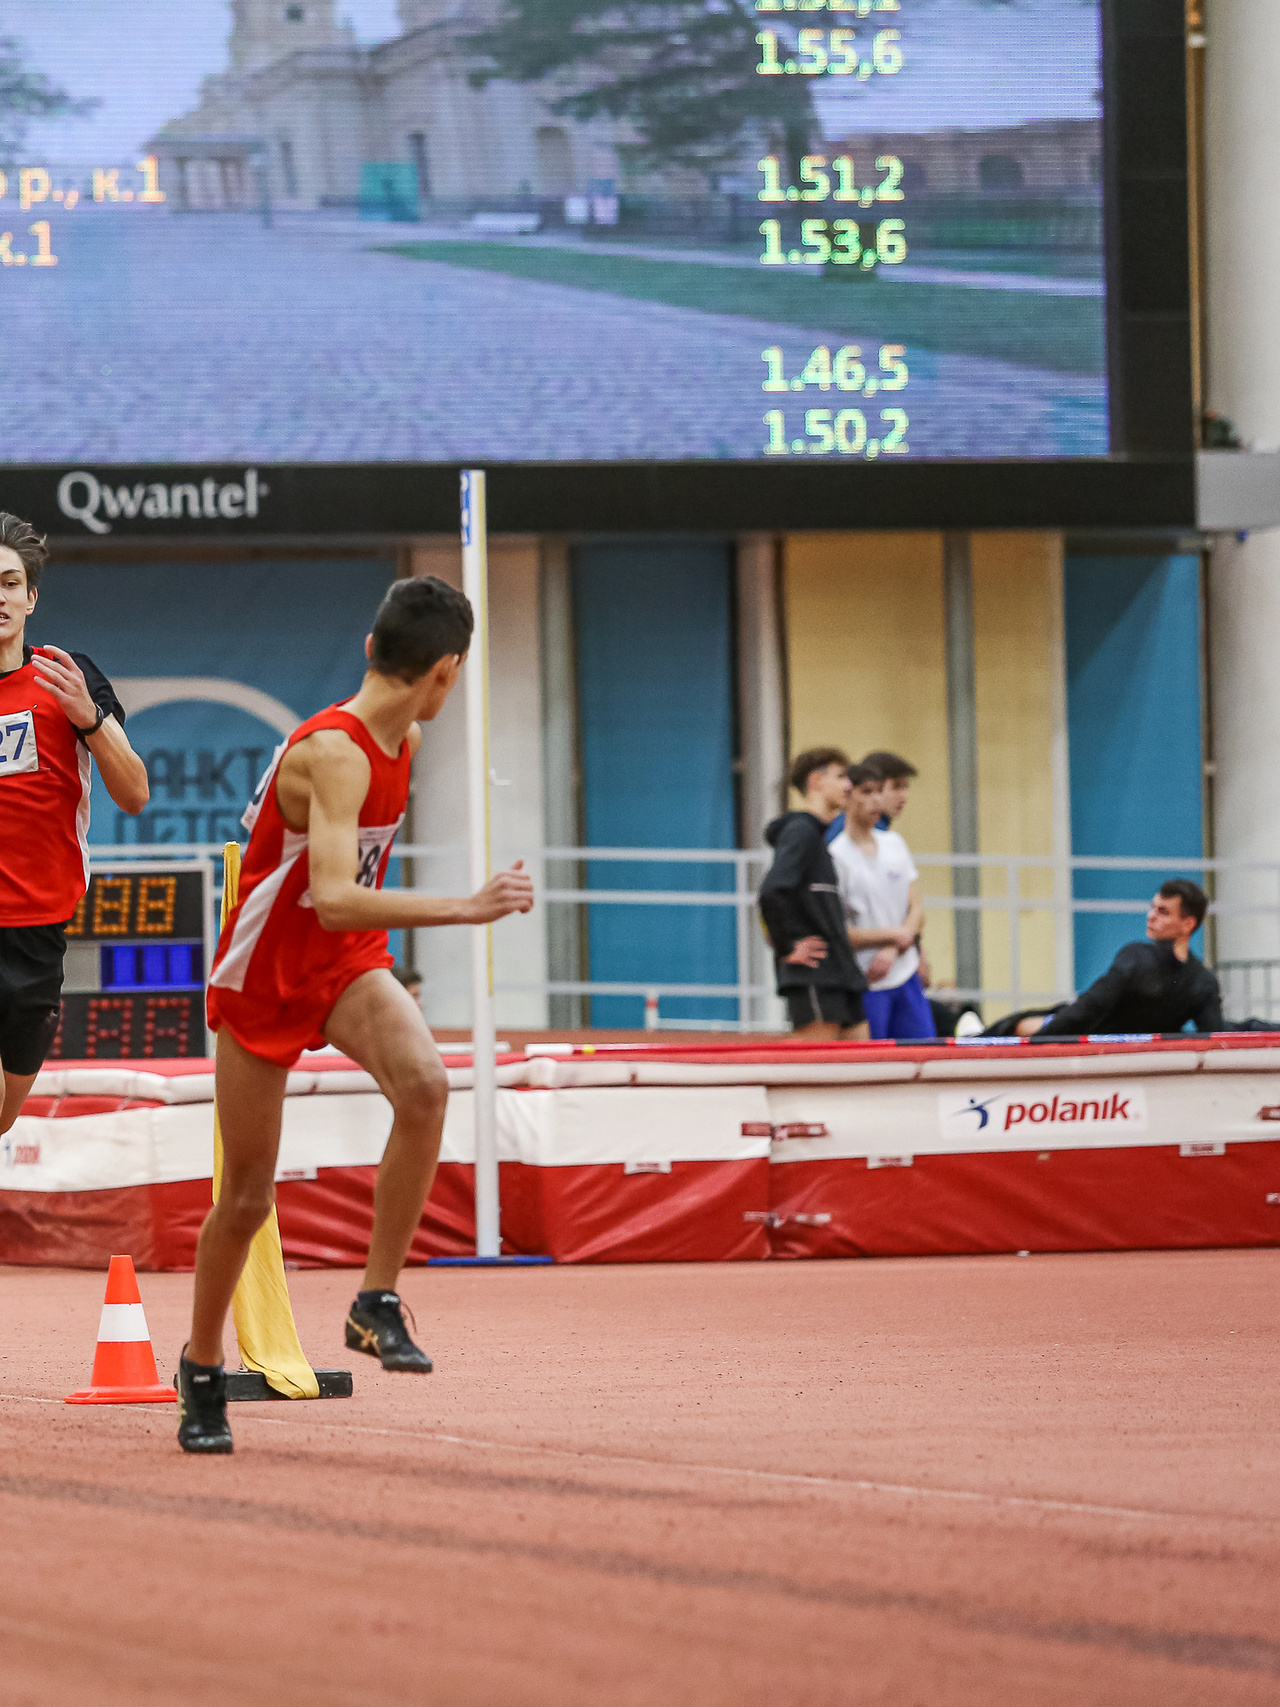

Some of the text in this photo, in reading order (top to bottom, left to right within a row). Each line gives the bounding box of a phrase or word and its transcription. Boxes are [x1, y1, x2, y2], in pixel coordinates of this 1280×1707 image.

[755, 28, 903, 82] 1.55,6
[19, 166, 79, 212] р.,
[91, 155, 166, 204] к.1
[757, 154, 905, 208] 1.51,2
[759, 218, 908, 271] 1.53,6
[761, 344, 910, 398] 1.46,5
[762, 408, 910, 461] 1.50,2
[57, 467, 259, 534] Qwantel
[1004, 1093, 1129, 1130] polanik
